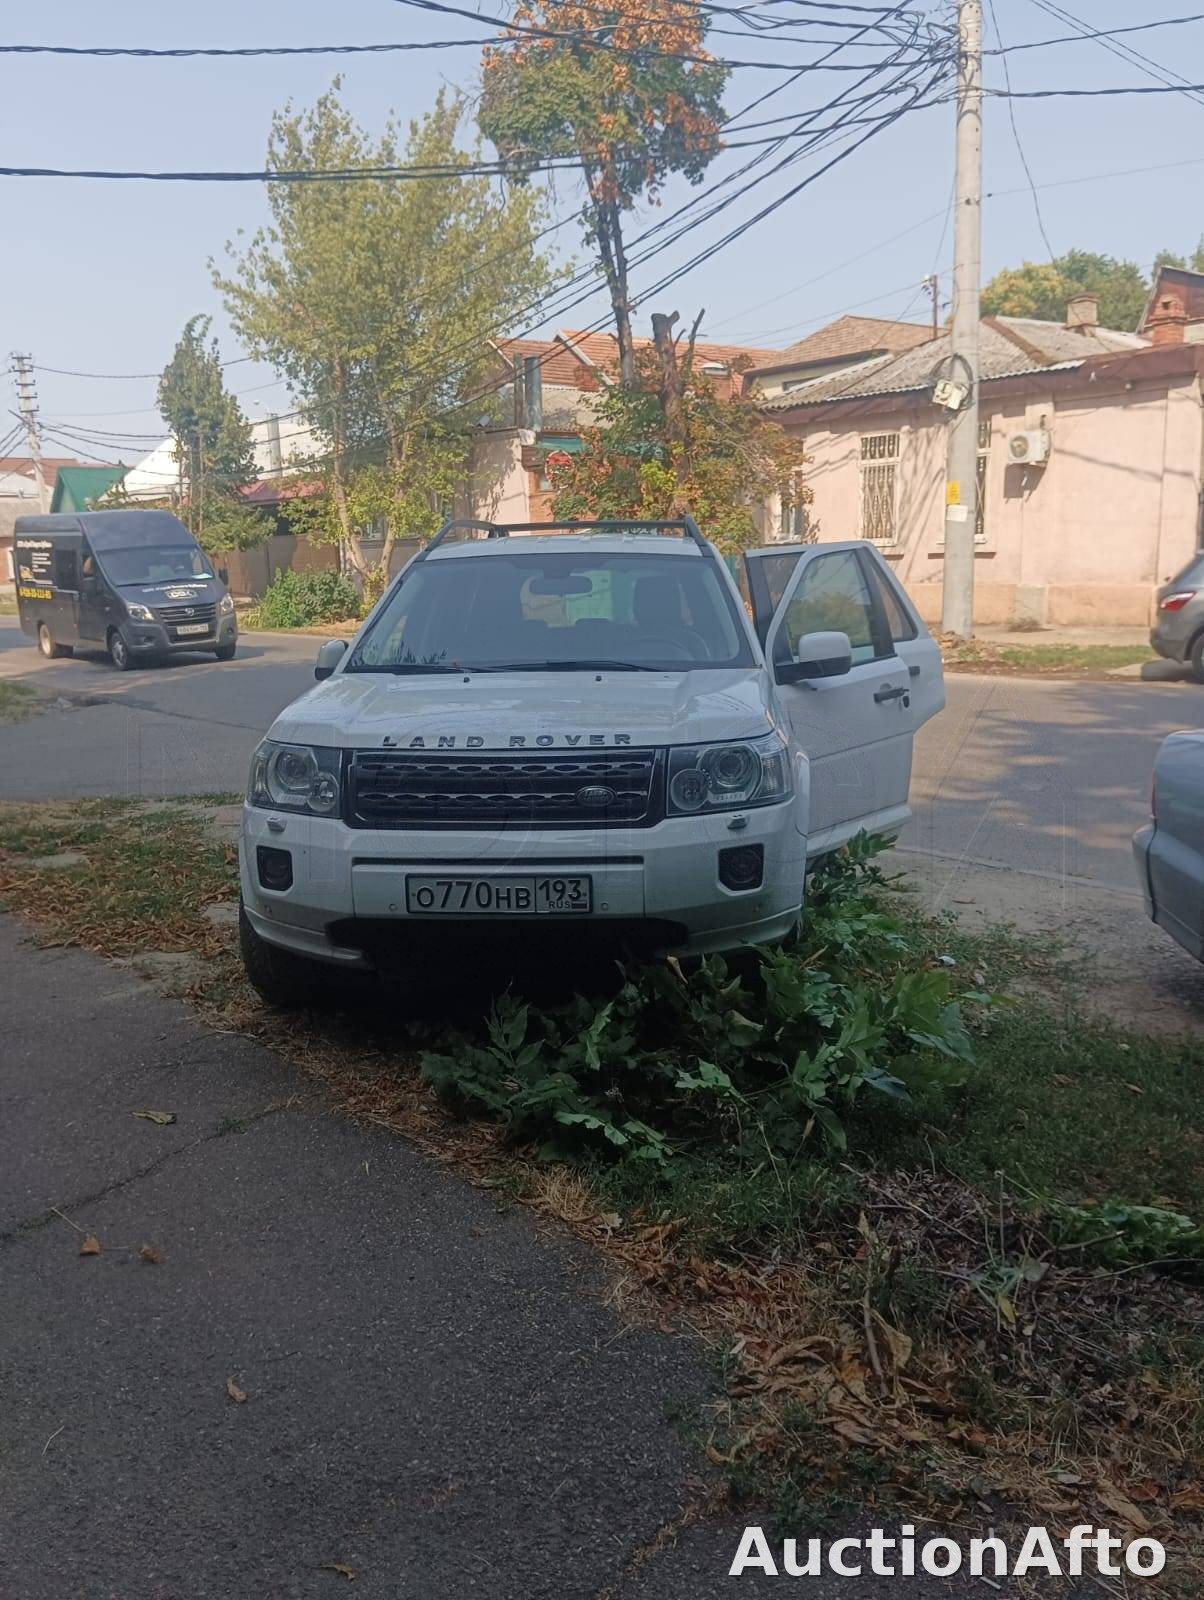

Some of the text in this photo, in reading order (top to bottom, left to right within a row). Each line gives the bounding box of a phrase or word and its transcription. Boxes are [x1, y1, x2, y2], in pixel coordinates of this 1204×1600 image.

[383, 734, 632, 747] LAND ROVER
[539, 880, 582, 902] 193
[549, 901, 571, 909] RUS
